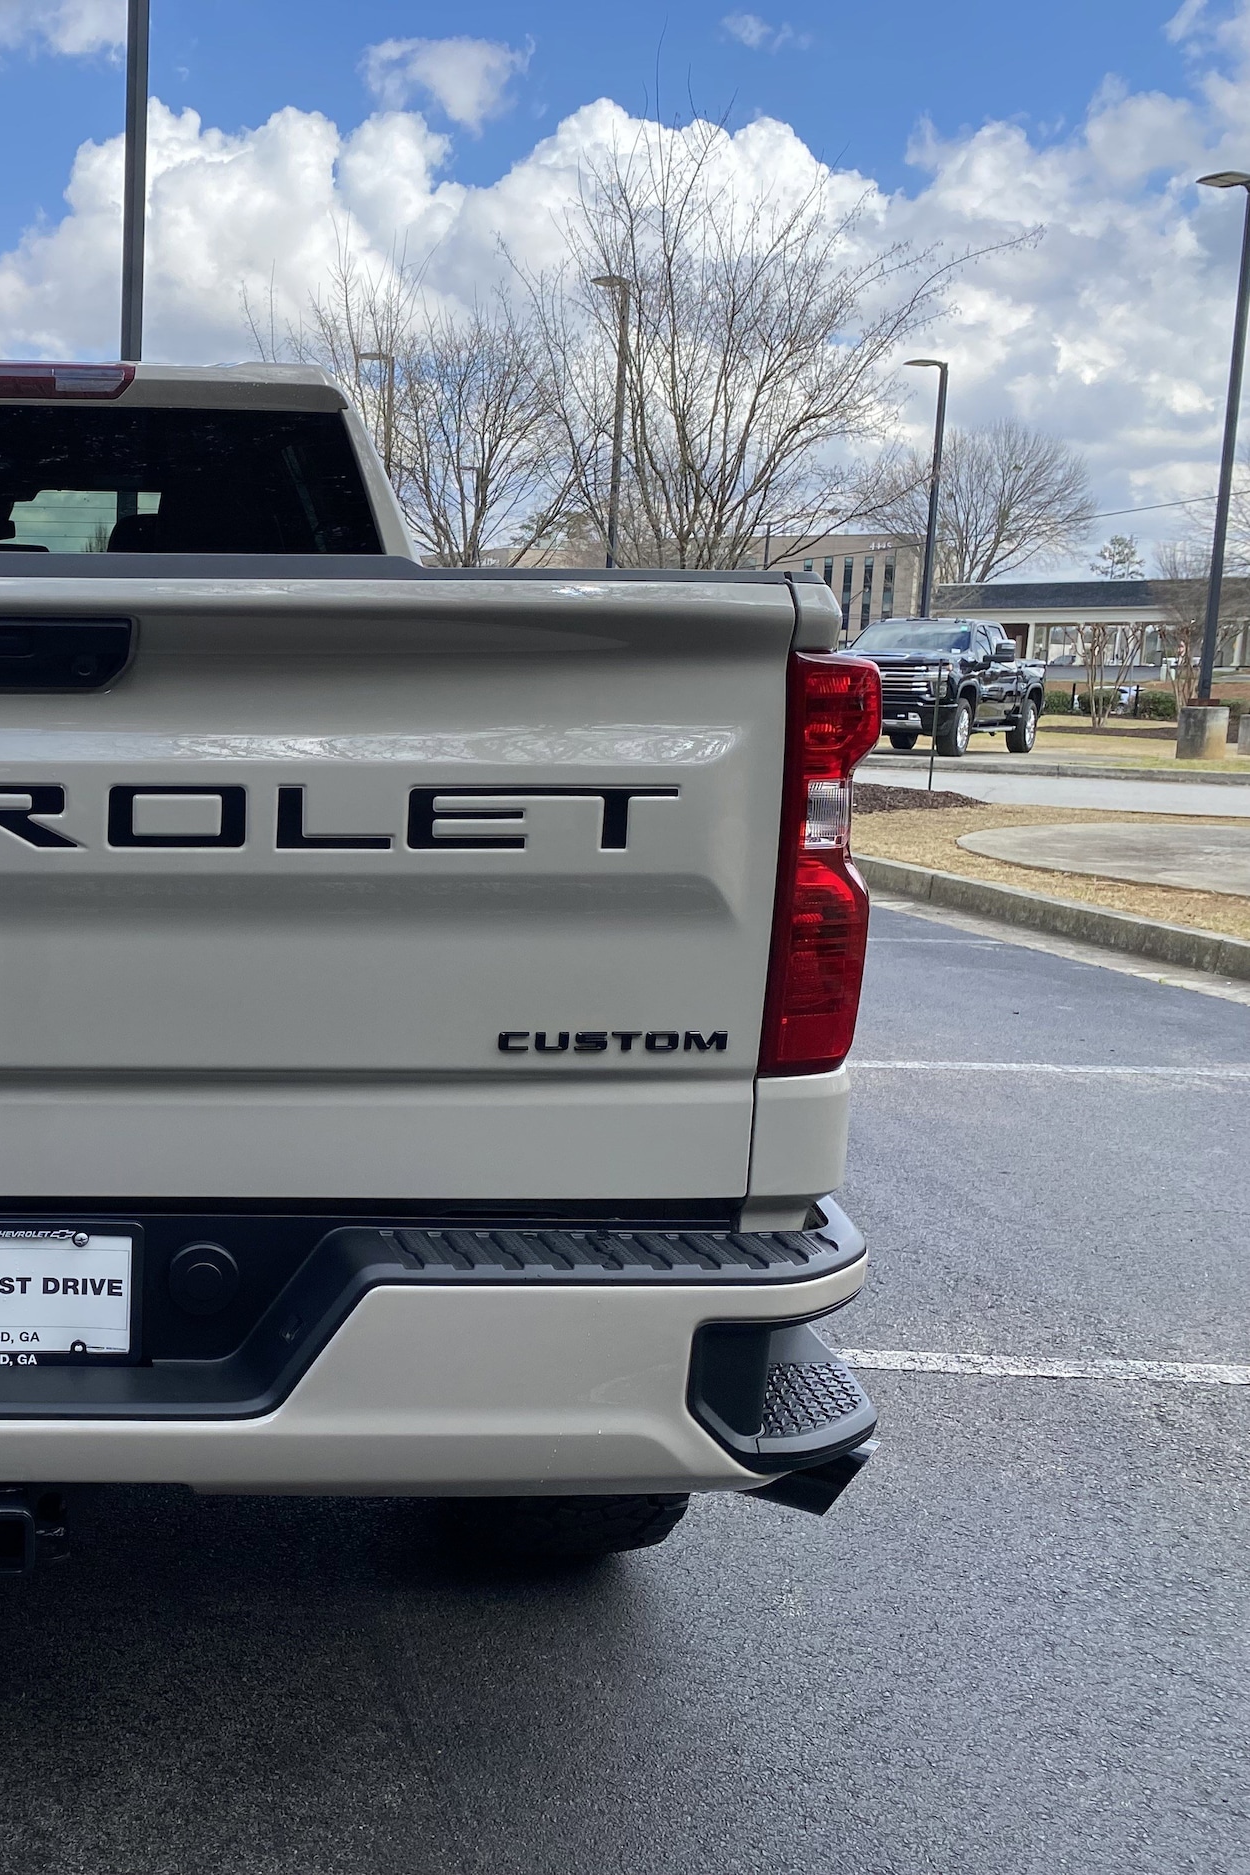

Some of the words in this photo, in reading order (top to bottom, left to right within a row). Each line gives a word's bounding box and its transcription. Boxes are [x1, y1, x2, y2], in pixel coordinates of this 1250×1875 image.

[498, 1031, 729, 1051] CUSTOM
[42, 1277, 123, 1297] DRIVE
[19, 1331, 40, 1343] GA
[17, 1353, 38, 1365] GA
